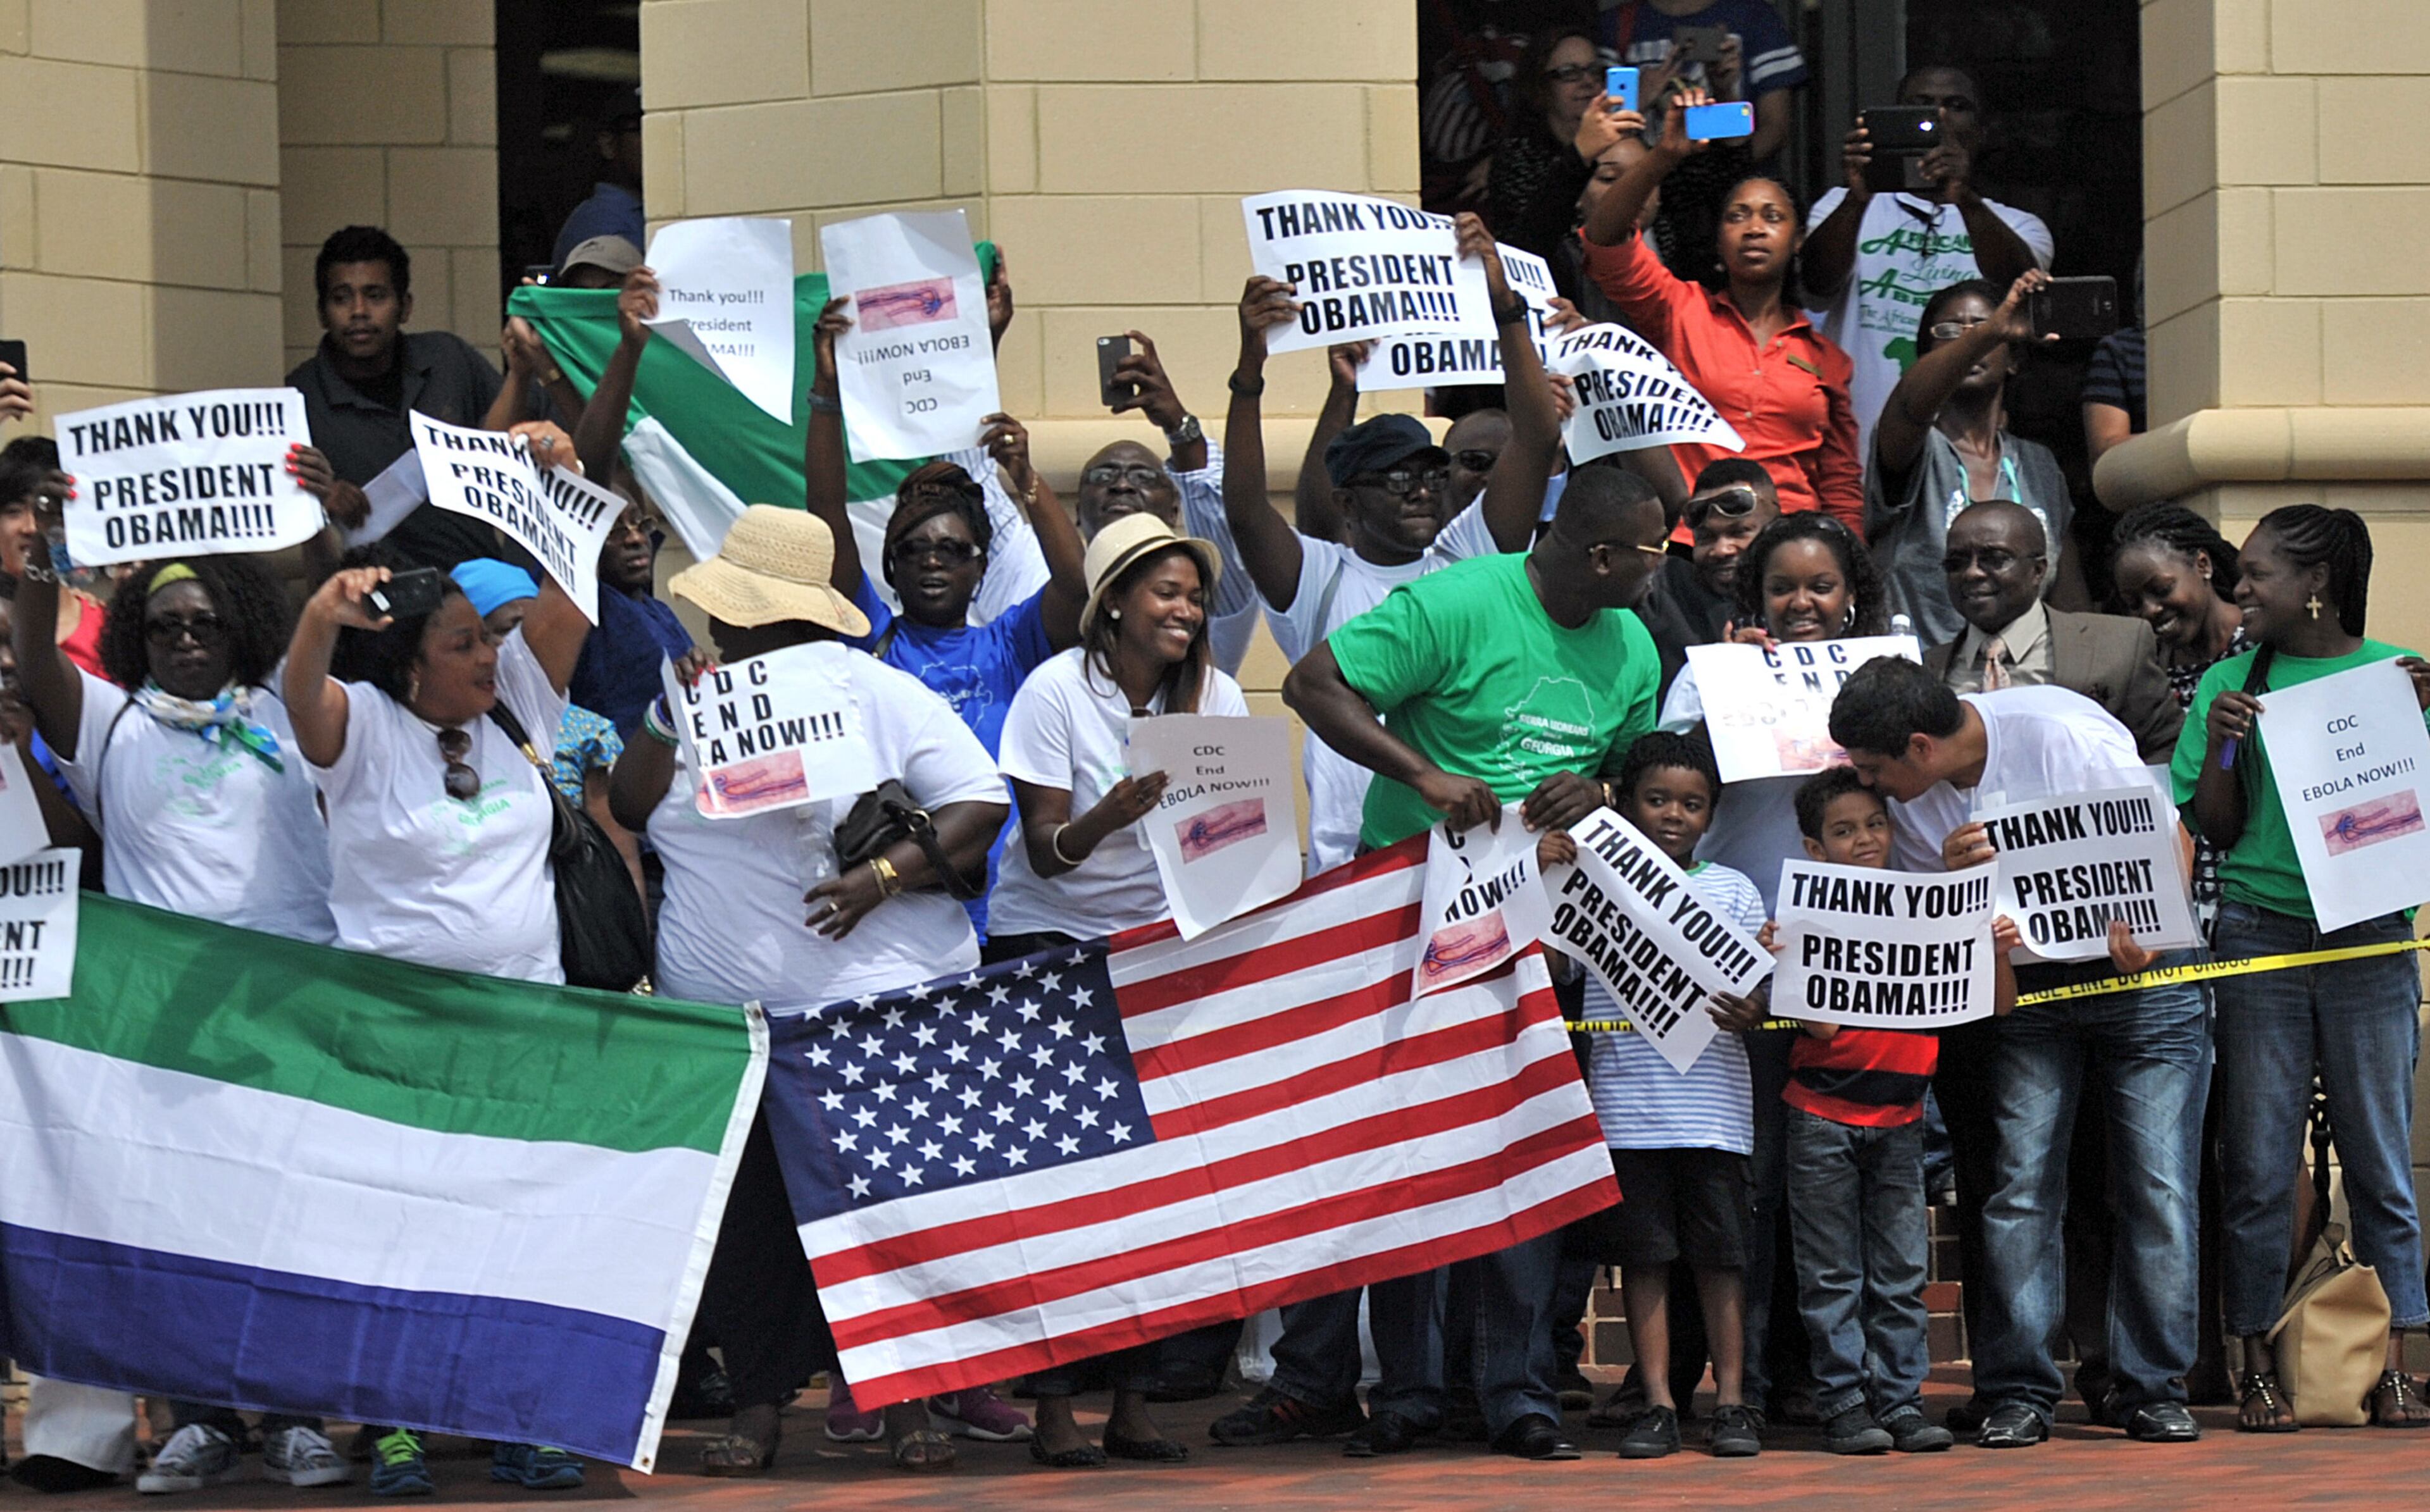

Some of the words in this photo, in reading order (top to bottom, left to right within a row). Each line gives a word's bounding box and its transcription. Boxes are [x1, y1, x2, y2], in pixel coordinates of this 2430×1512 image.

[1256, 202, 1366, 240] THANK
[1285, 254, 1454, 296] PRESIDENT
[668, 288, 714, 302] Thank
[718, 290, 764, 306] you!!!
[1300, 290, 1460, 335] OBAMA!!!!
[857, 342, 914, 365] NOW!!!
[918, 335, 970, 353] EBOLA
[1559, 332, 1657, 361] THANK
[903, 369, 933, 386] End
[906, 397, 938, 414] CDC
[1593, 403, 1712, 442] OBAMA!!!!
[68, 410, 181, 456] THANK
[187, 402, 285, 438] YOU!!!
[94, 464, 274, 511] PRESIDENT
[106, 504, 276, 548] OBAMA!!!!
[450, 462, 577, 566] PRESIDENT
[736, 712, 844, 758] NOW!!!
[2327, 714, 2358, 734] CDC
[1193, 745, 1226, 757] CDC
[1520, 737, 1574, 757] GEORGIA
[2336, 741, 2365, 761] End
[1195, 765, 1225, 776] End
[2302, 777, 2354, 802] EBOLA
[2357, 757, 2415, 786] NOW!!!
[1160, 784, 1206, 809] EBOLA
[1210, 778, 1270, 792] NOW!!!
[1983, 805, 2087, 853] THANK
[2087, 798, 2155, 836] YOU!!!
[1583, 819, 1679, 910] THANK
[1668, 893, 1758, 985] YOU!!!
[1792, 873, 1896, 917] THANK
[1904, 876, 1989, 919] YOU!!!
[2012, 858, 2154, 908] PRESIDENT
[1561, 867, 1708, 1013] PRESIDENT
[2029, 898, 2162, 946] OBAMA!!!!
[1550, 902, 1681, 1039] OBAMA!!!!
[1802, 934, 1976, 977] PRESIDENT
[1806, 974, 1969, 1015] OBAMA!!!!
